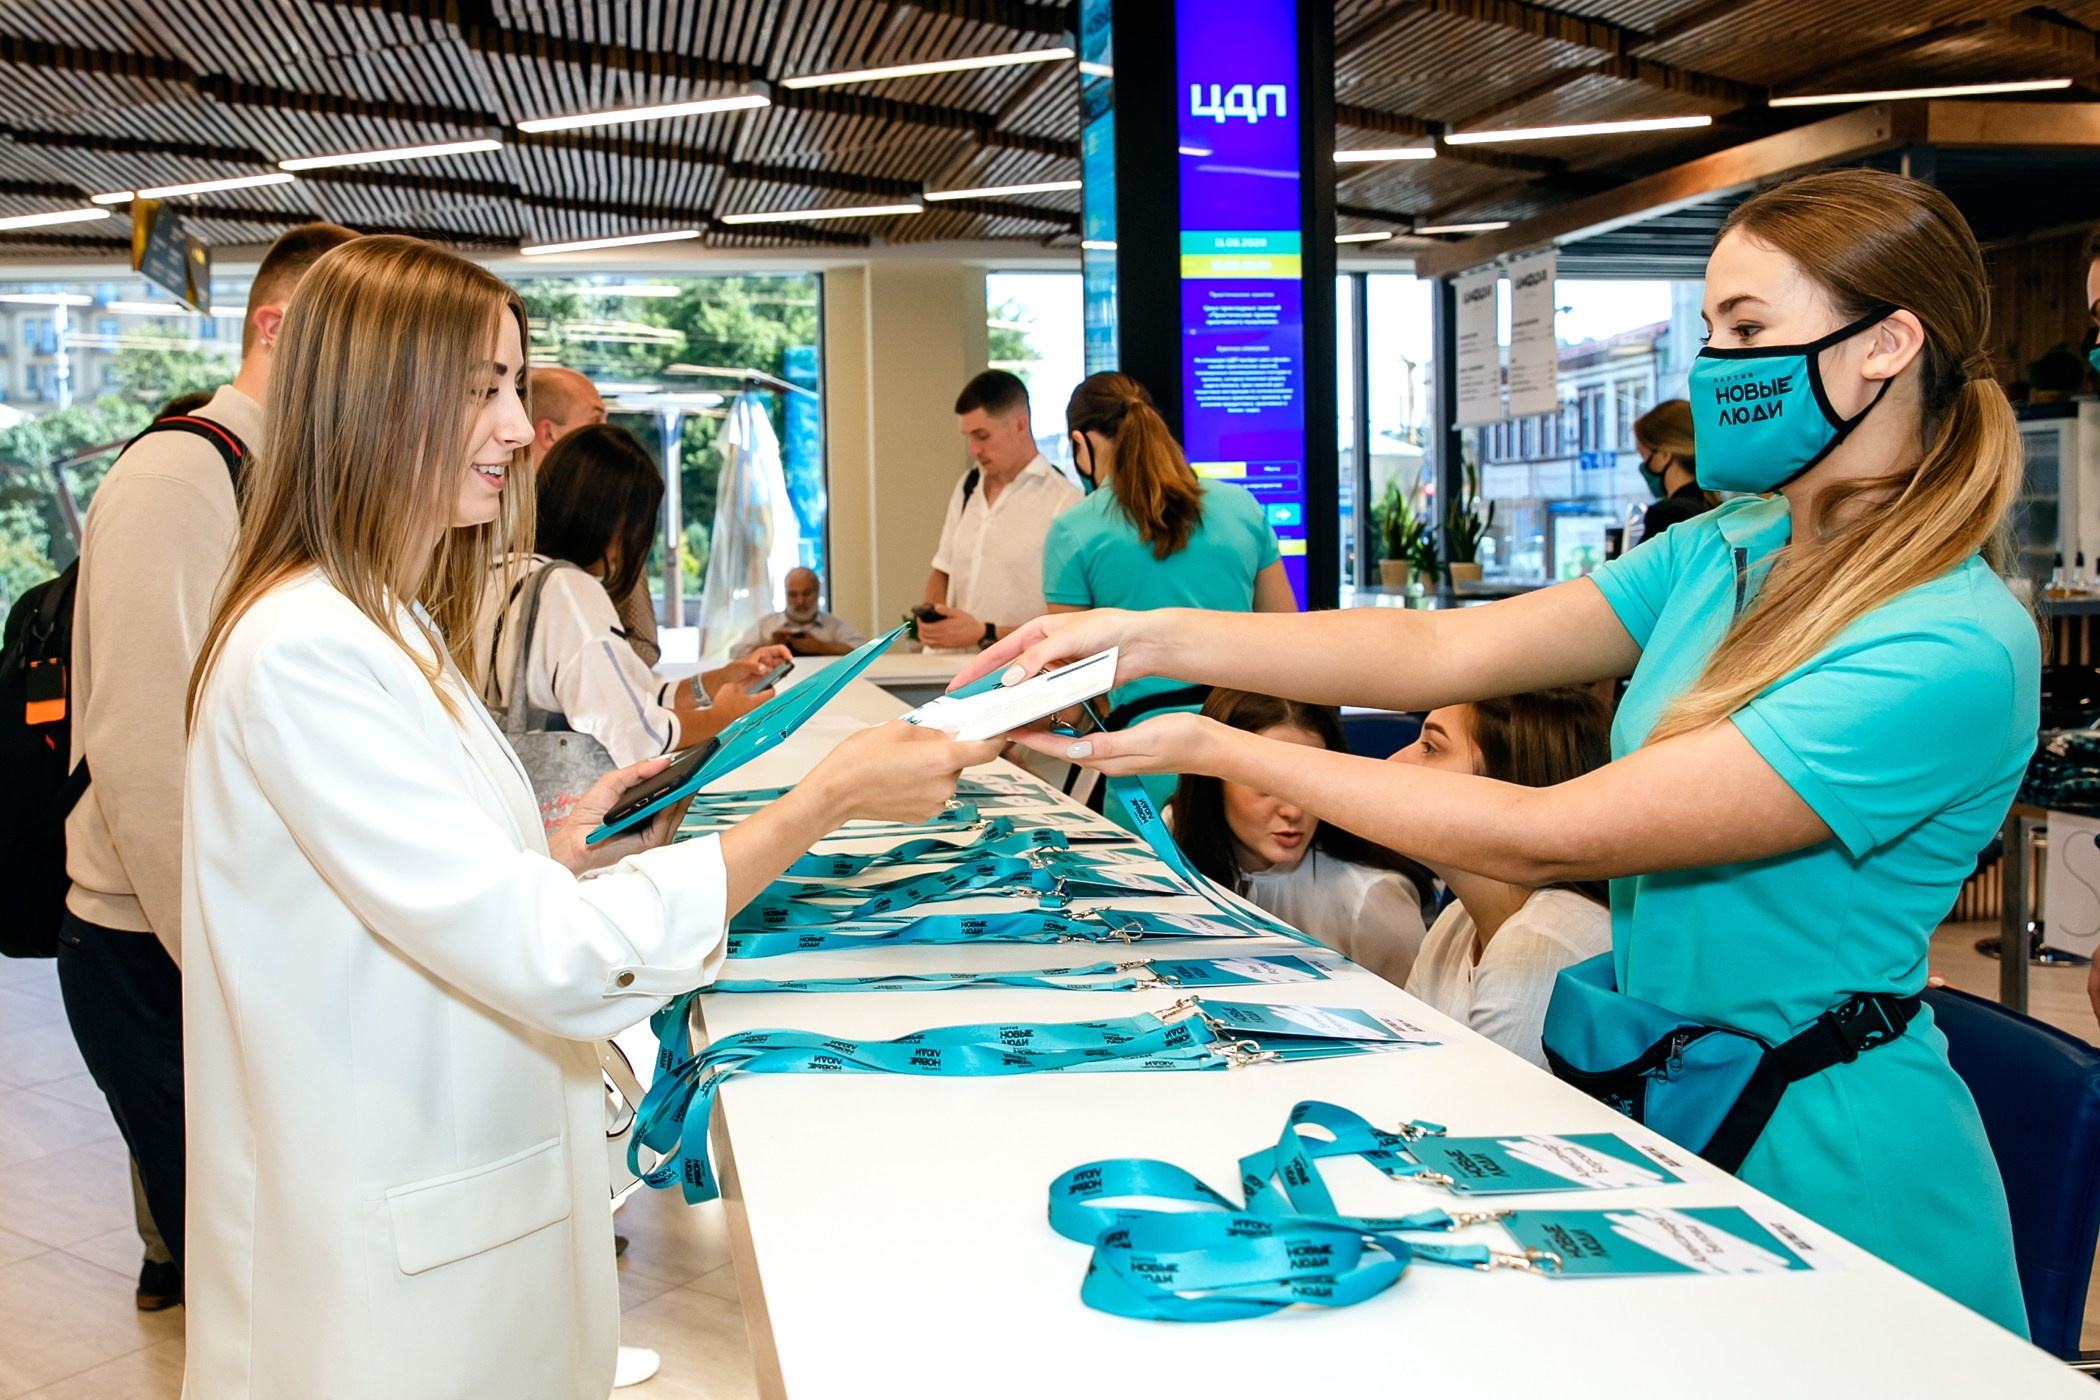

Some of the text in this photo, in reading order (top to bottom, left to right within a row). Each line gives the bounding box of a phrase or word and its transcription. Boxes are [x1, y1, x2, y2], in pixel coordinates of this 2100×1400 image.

[1713, 372, 1754, 384] ПАРТИЯ
[1715, 375, 1793, 405] НОВЫЕ
[1718, 400, 1783, 427] ЛЮДИ
[1139, 798, 1154, 820] ЛЮДИ
[1000, 1029, 1034, 1039] НОВЫЕ
[1164, 1025, 1188, 1039] ЛЮДИ
[915, 1048, 941, 1057] ЛЮДИ
[814, 1055, 842, 1064] ЛЮДИ
[909, 1057, 941, 1066] НОВЫЕ
[808, 1062, 842, 1071] НОВЫЕ
[685, 1157, 694, 1184] ЛЮДИ
[692, 1159, 704, 1188] НОВЫЕ
[1073, 1168, 1102, 1183] ЛЮДИ
[1068, 1179, 1102, 1196] НОВЫЕ
[1286, 1244, 1334, 1257] НОВЫЕ
[1131, 1262, 1179, 1273] НОВЫЕ
[1290, 1257, 1330, 1270] ЛЮДИ
